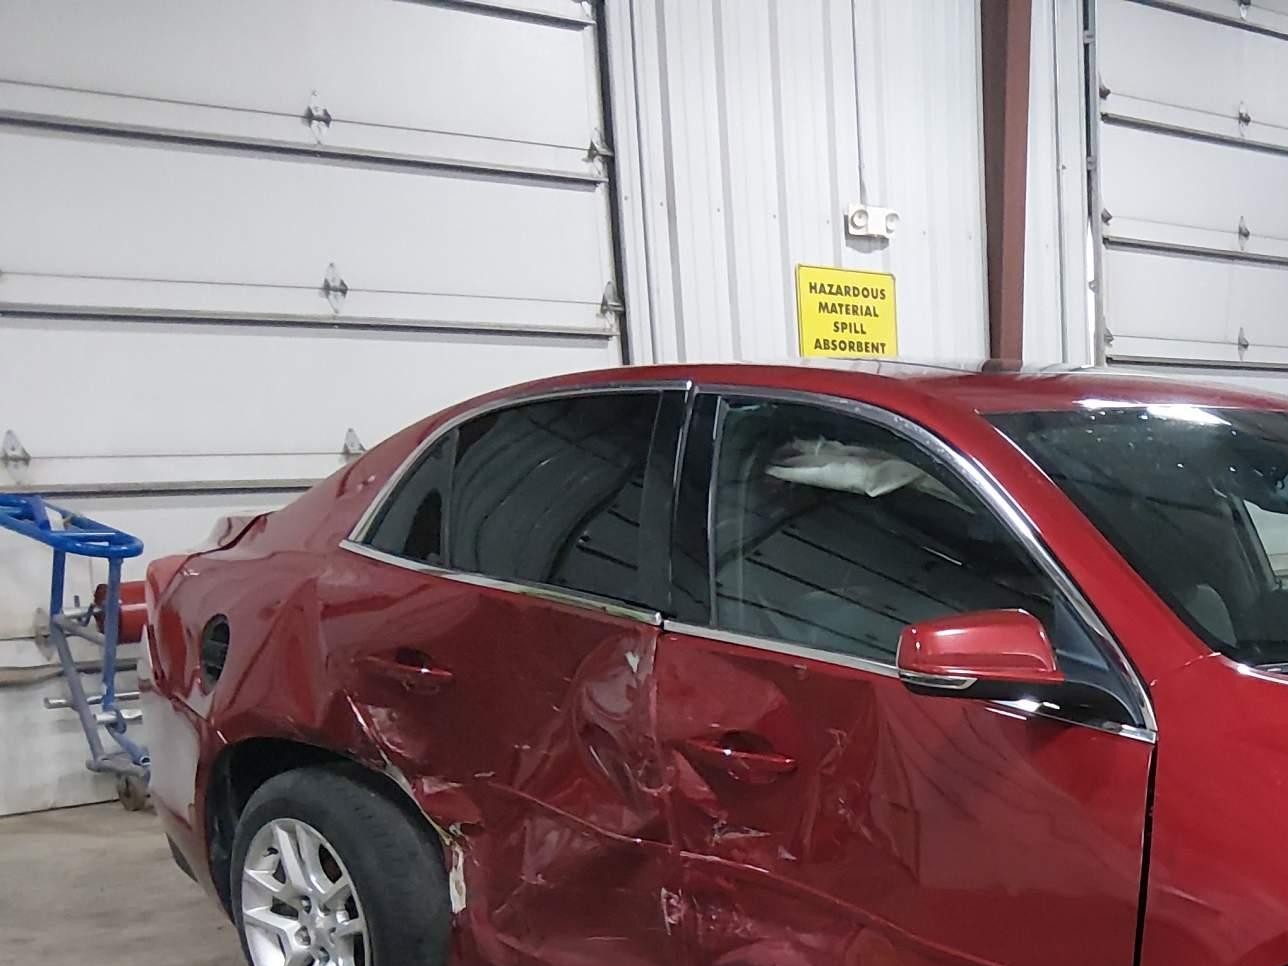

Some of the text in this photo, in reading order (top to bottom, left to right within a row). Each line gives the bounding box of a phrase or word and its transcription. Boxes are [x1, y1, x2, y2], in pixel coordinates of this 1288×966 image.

[809, 282, 886, 300] HAZARDOUS
[818, 302, 879, 318] MATERIAL
[833, 321, 866, 335] SPILL
[814, 338, 886, 354] ABSORBENT
